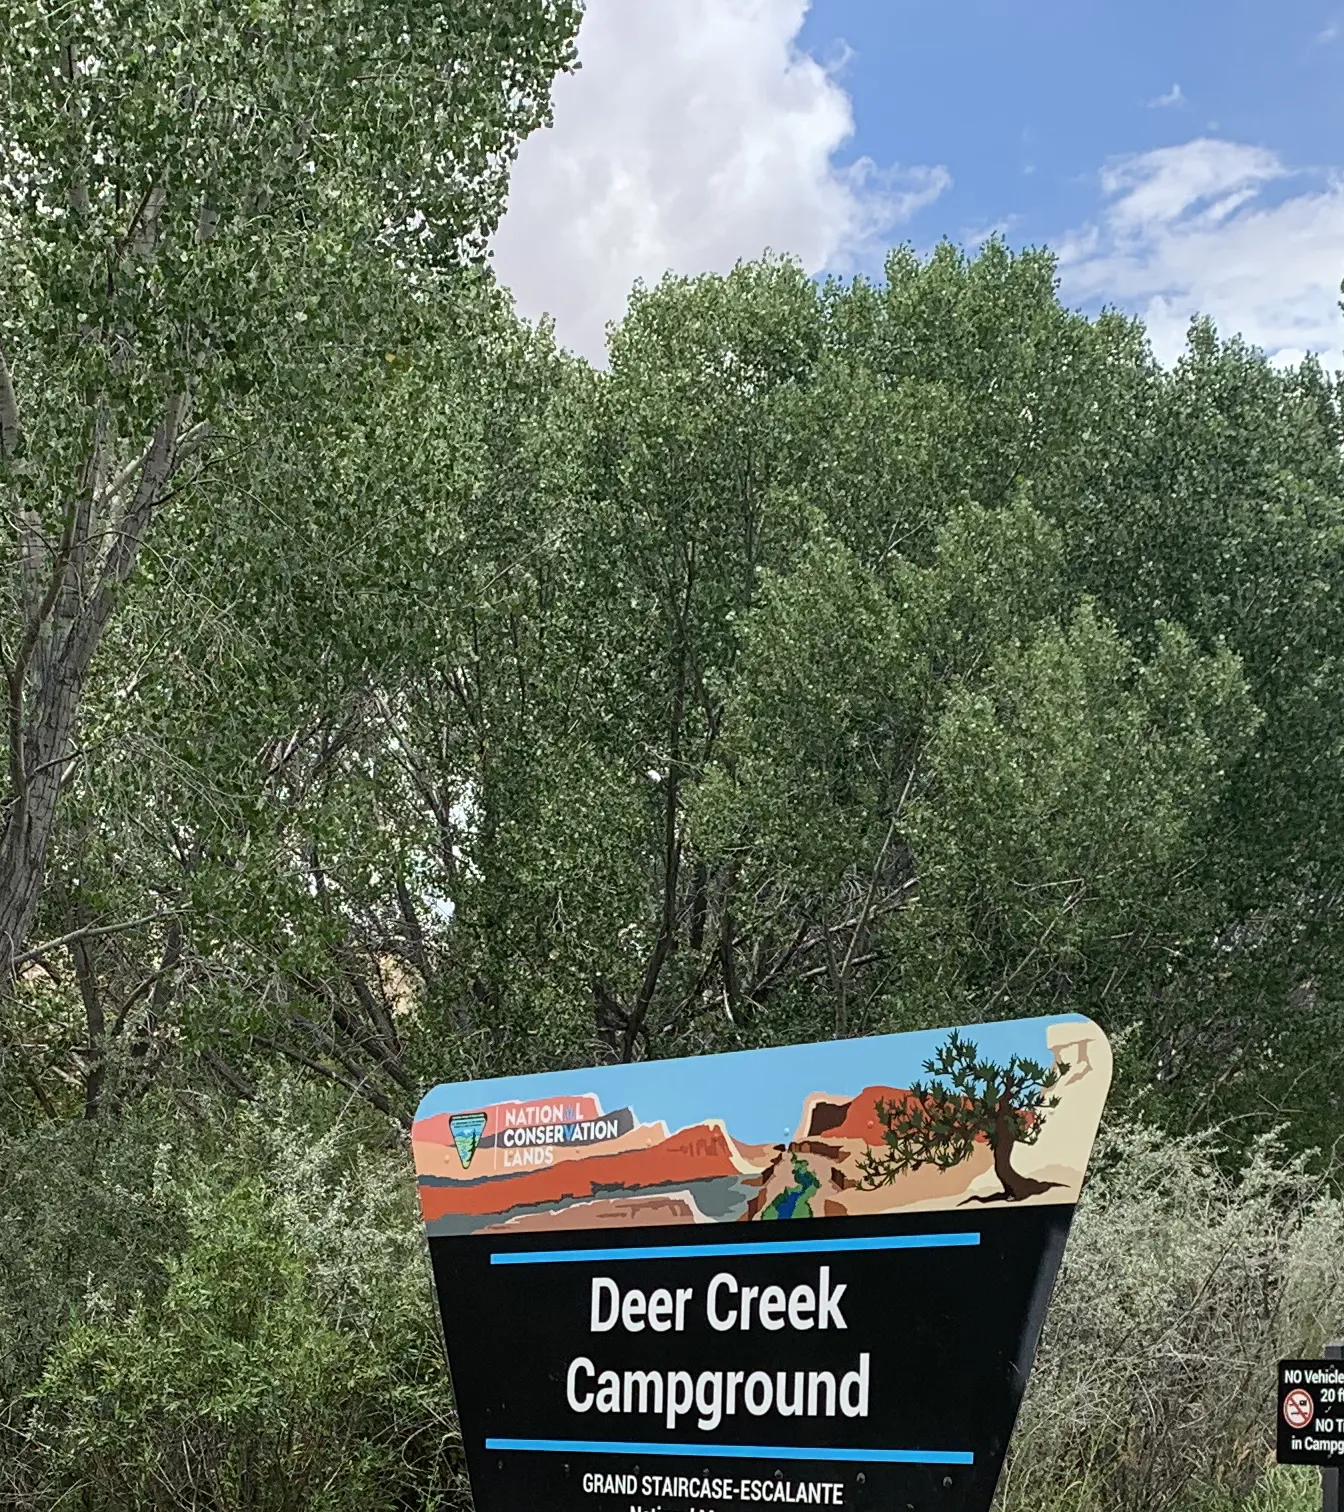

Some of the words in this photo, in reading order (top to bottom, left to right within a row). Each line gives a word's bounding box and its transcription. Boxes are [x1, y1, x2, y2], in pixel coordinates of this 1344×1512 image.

[503, 1119, 618, 1147] CONSERVATION
[504, 1146, 554, 1167] LANDS
[590, 1276, 693, 1332] Deer
[706, 1266, 848, 1331] Creek
[1284, 1370, 1302, 1384] NO
[566, 1352, 870, 1431] Campground
[1320, 1388, 1336, 1403] 20
[1315, 1418, 1334, 1432] NO
[1291, 1435, 1302, 1450] in
[582, 1473, 638, 1495] GRAND
[641, 1475, 844, 1505] STAIRCASE-ESCALANTE
